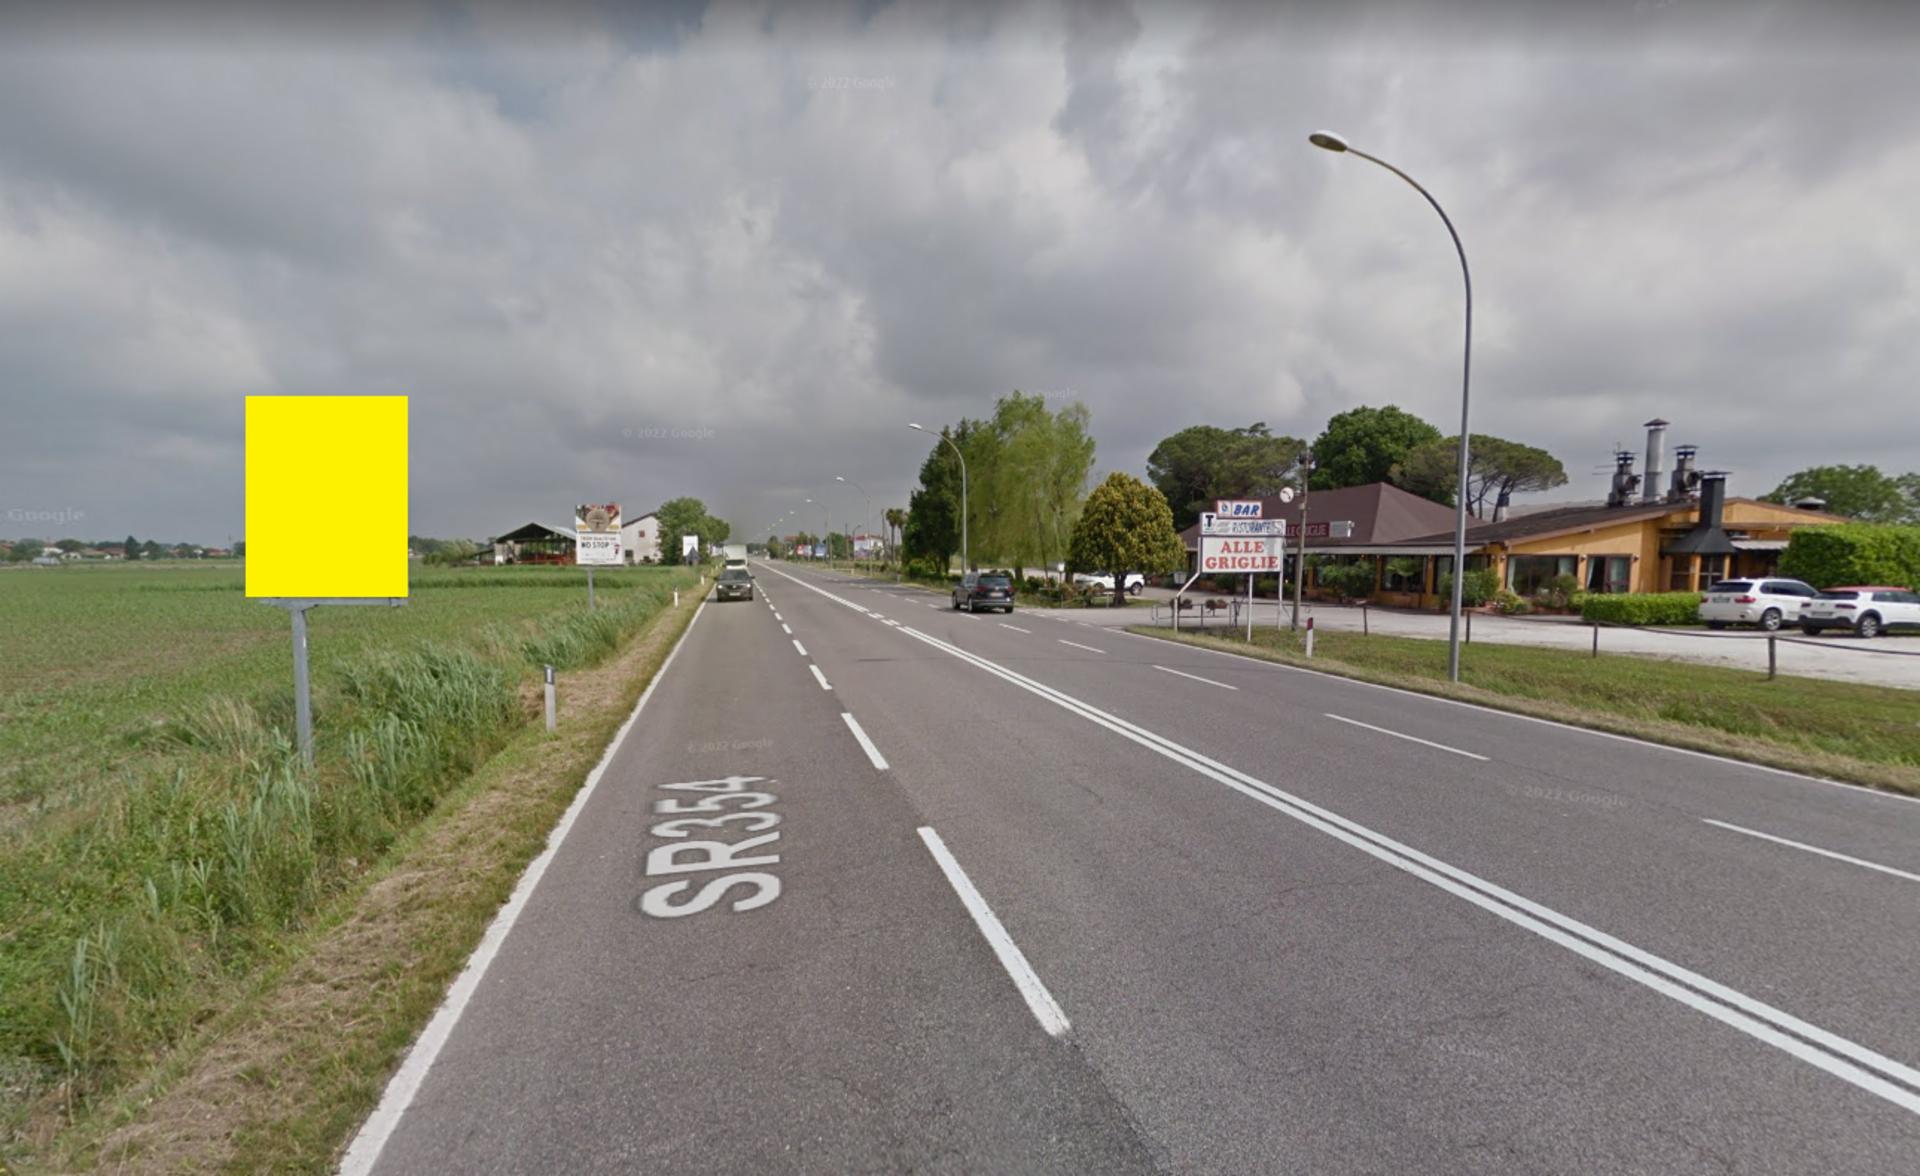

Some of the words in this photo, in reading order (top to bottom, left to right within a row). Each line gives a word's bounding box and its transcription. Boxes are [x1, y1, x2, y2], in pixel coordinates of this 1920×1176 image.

[1233, 504, 1260, 516] BAR
[1220, 541, 1265, 553] ALLE
[1204, 555, 1279, 570] GRIGLIE
[641, 776, 781, 918] SR354
